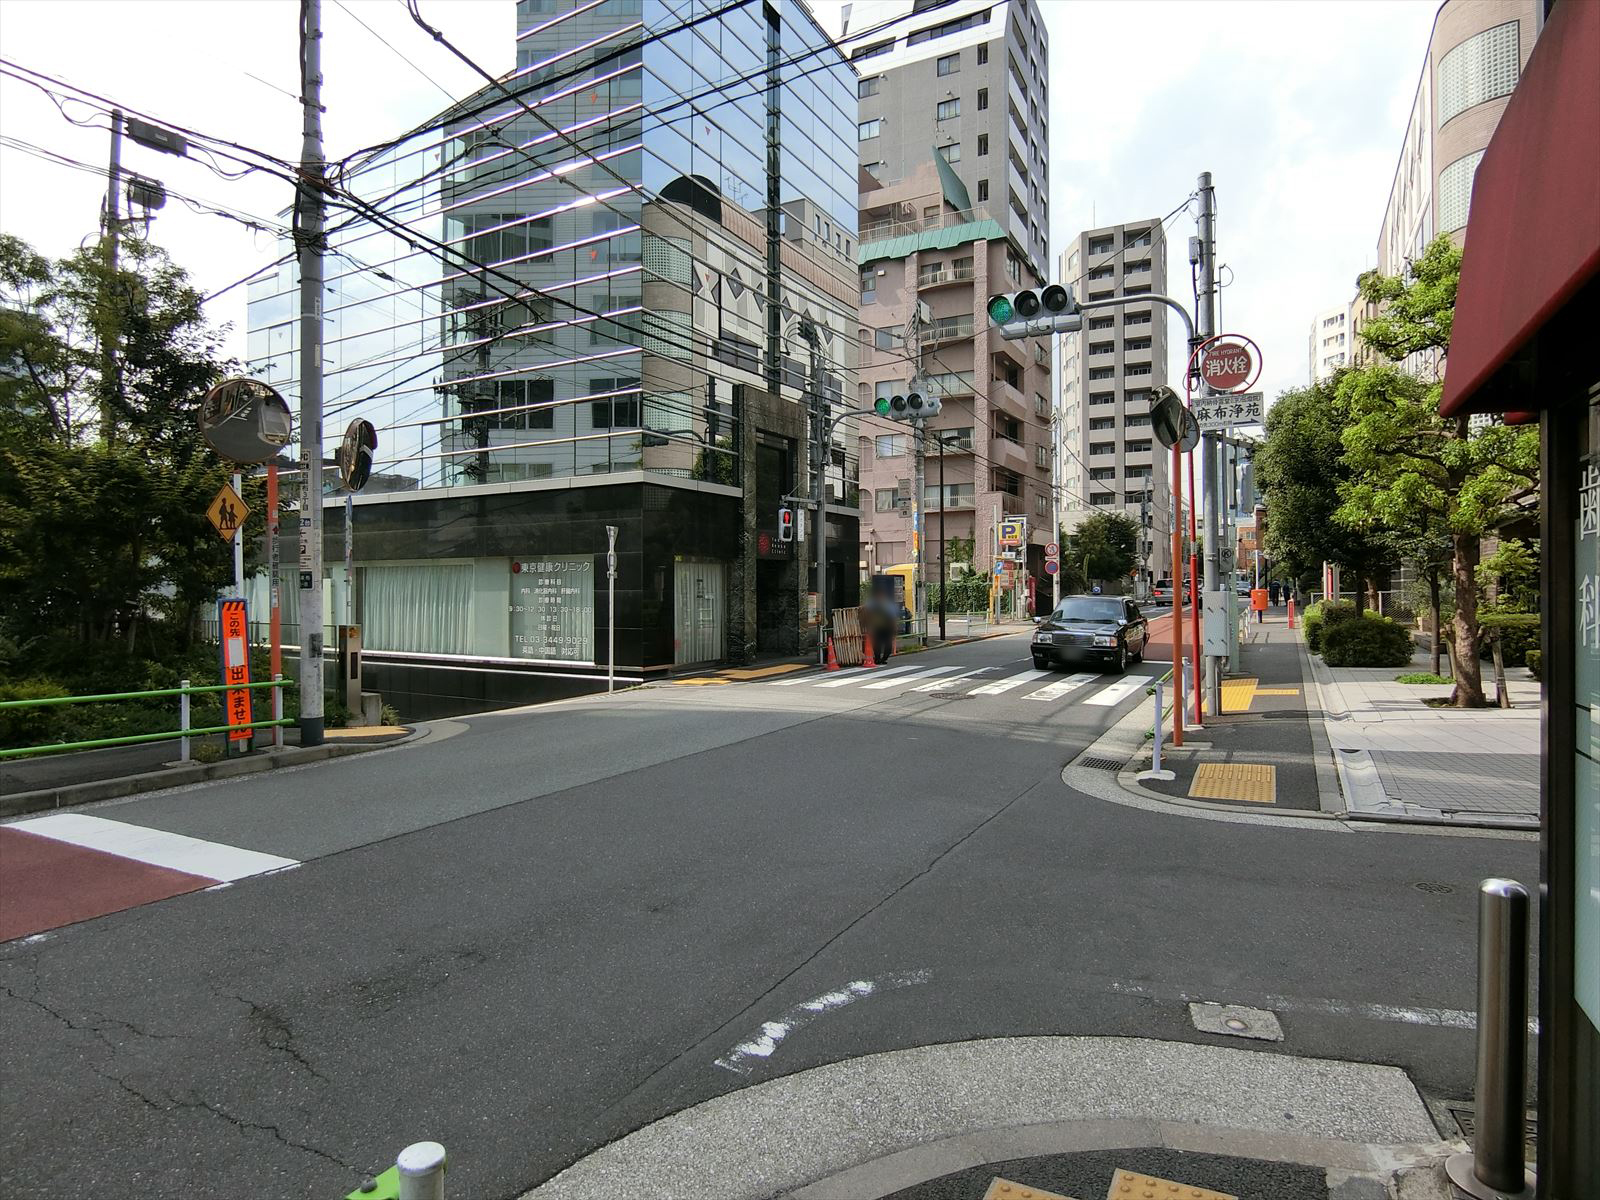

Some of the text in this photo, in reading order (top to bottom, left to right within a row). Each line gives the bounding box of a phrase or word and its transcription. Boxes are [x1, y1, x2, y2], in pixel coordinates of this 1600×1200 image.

[1221, 348, 1242, 356] HYDRANT
[1206, 355, 1248, 378] 消火栓
[1196, 402, 1261, 422] 麻布浄苑
[1002, 525, 1016, 539] P
[1579, 465, 1600, 648] 歯科
[521, 562, 590, 573] 東京健康クリニック
[521, 587, 531, 595] 内科
[229, 612, 240, 637] この先
